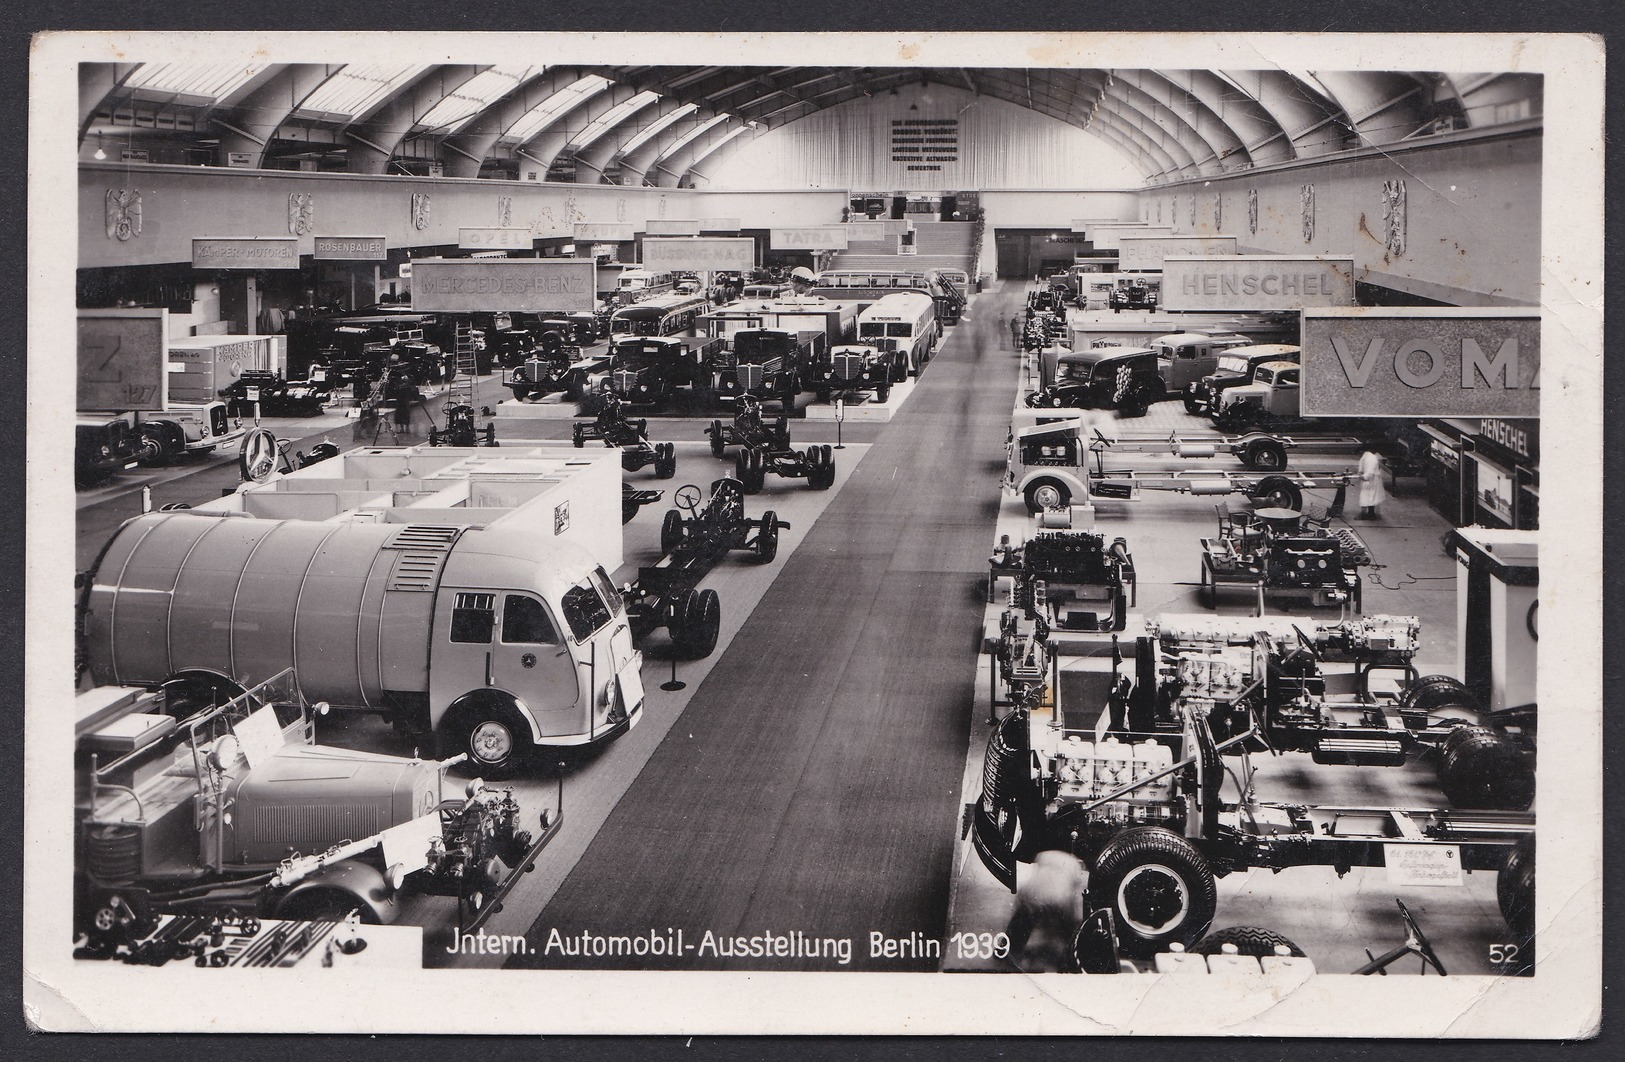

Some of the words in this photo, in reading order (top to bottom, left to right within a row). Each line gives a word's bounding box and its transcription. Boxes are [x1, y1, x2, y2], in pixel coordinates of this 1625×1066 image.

[471, 232, 521, 244] OPEL
[783, 233, 834, 244] TATRA
[319, 242, 382, 252] ROSENBAUER
[421, 276, 585, 294] MERCEDES-BENZ
[1183, 273, 1333, 296] HENSCHEL
[1480, 419, 1529, 458] HENSCHEL
